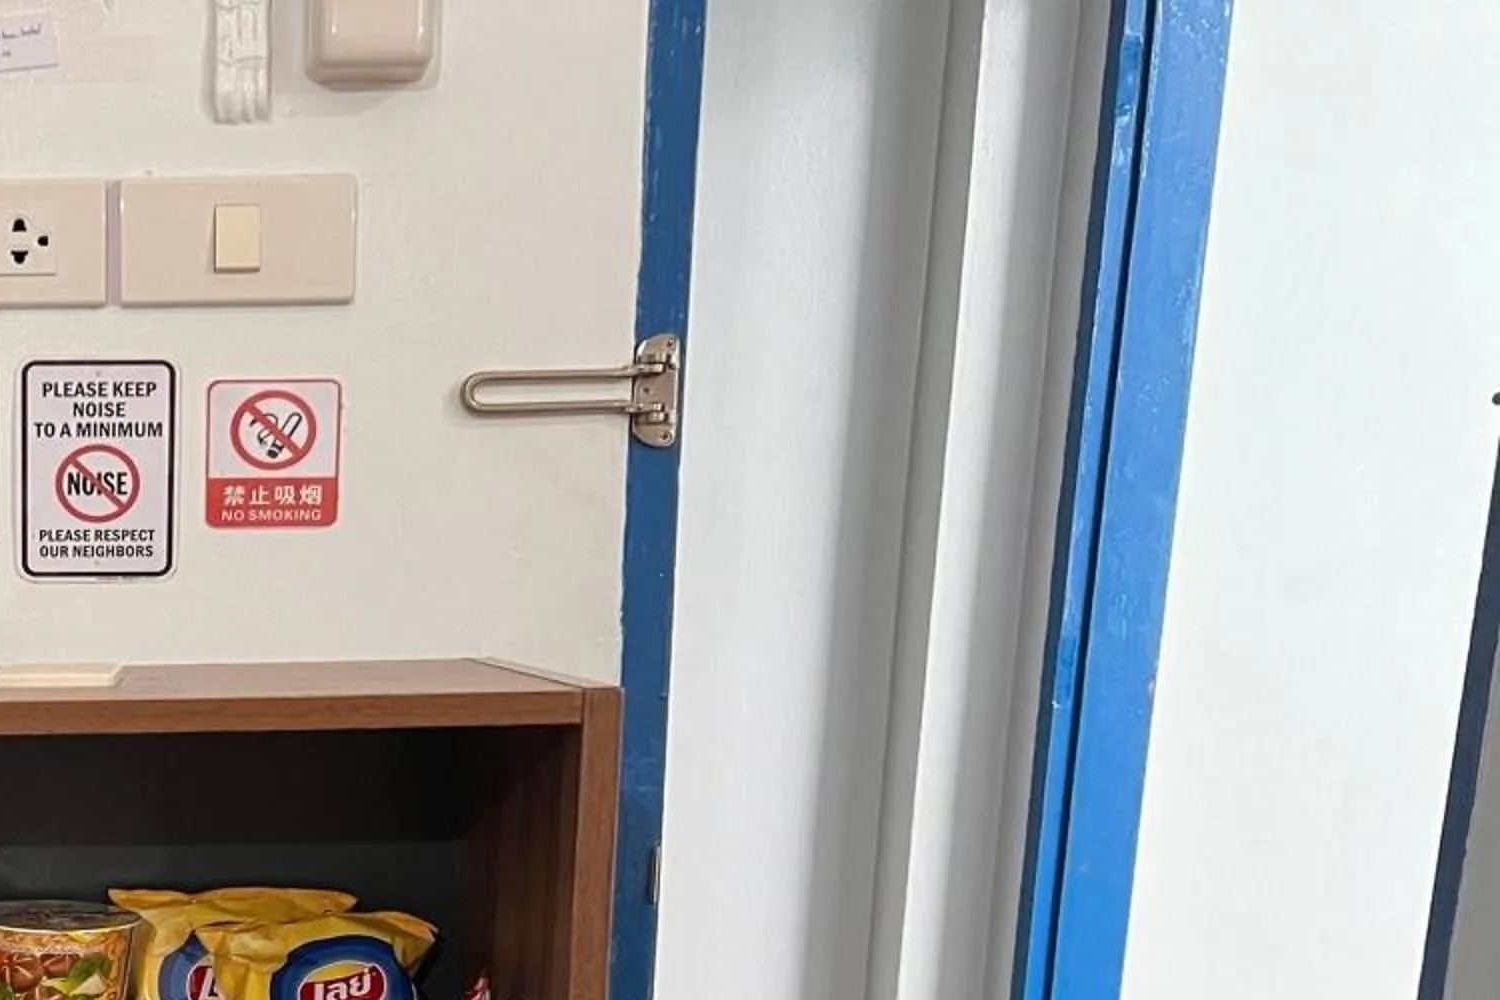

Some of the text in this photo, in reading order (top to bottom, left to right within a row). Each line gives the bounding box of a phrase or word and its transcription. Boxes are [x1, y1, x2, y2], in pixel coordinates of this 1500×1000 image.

[42, 382, 157, 397] PLEASE KEEP
[73, 402, 126, 417] NOISE
[34, 422, 163, 437] TO A MINIMUM
[67, 471, 128, 496] NOISE
[223, 484, 323, 507] 禁止吸烟
[221, 509, 321, 521] NO SMOKING
[40, 529, 156, 541] PLEASE RESPECT
[40, 545, 153, 558] OUR NEIGHBORS
